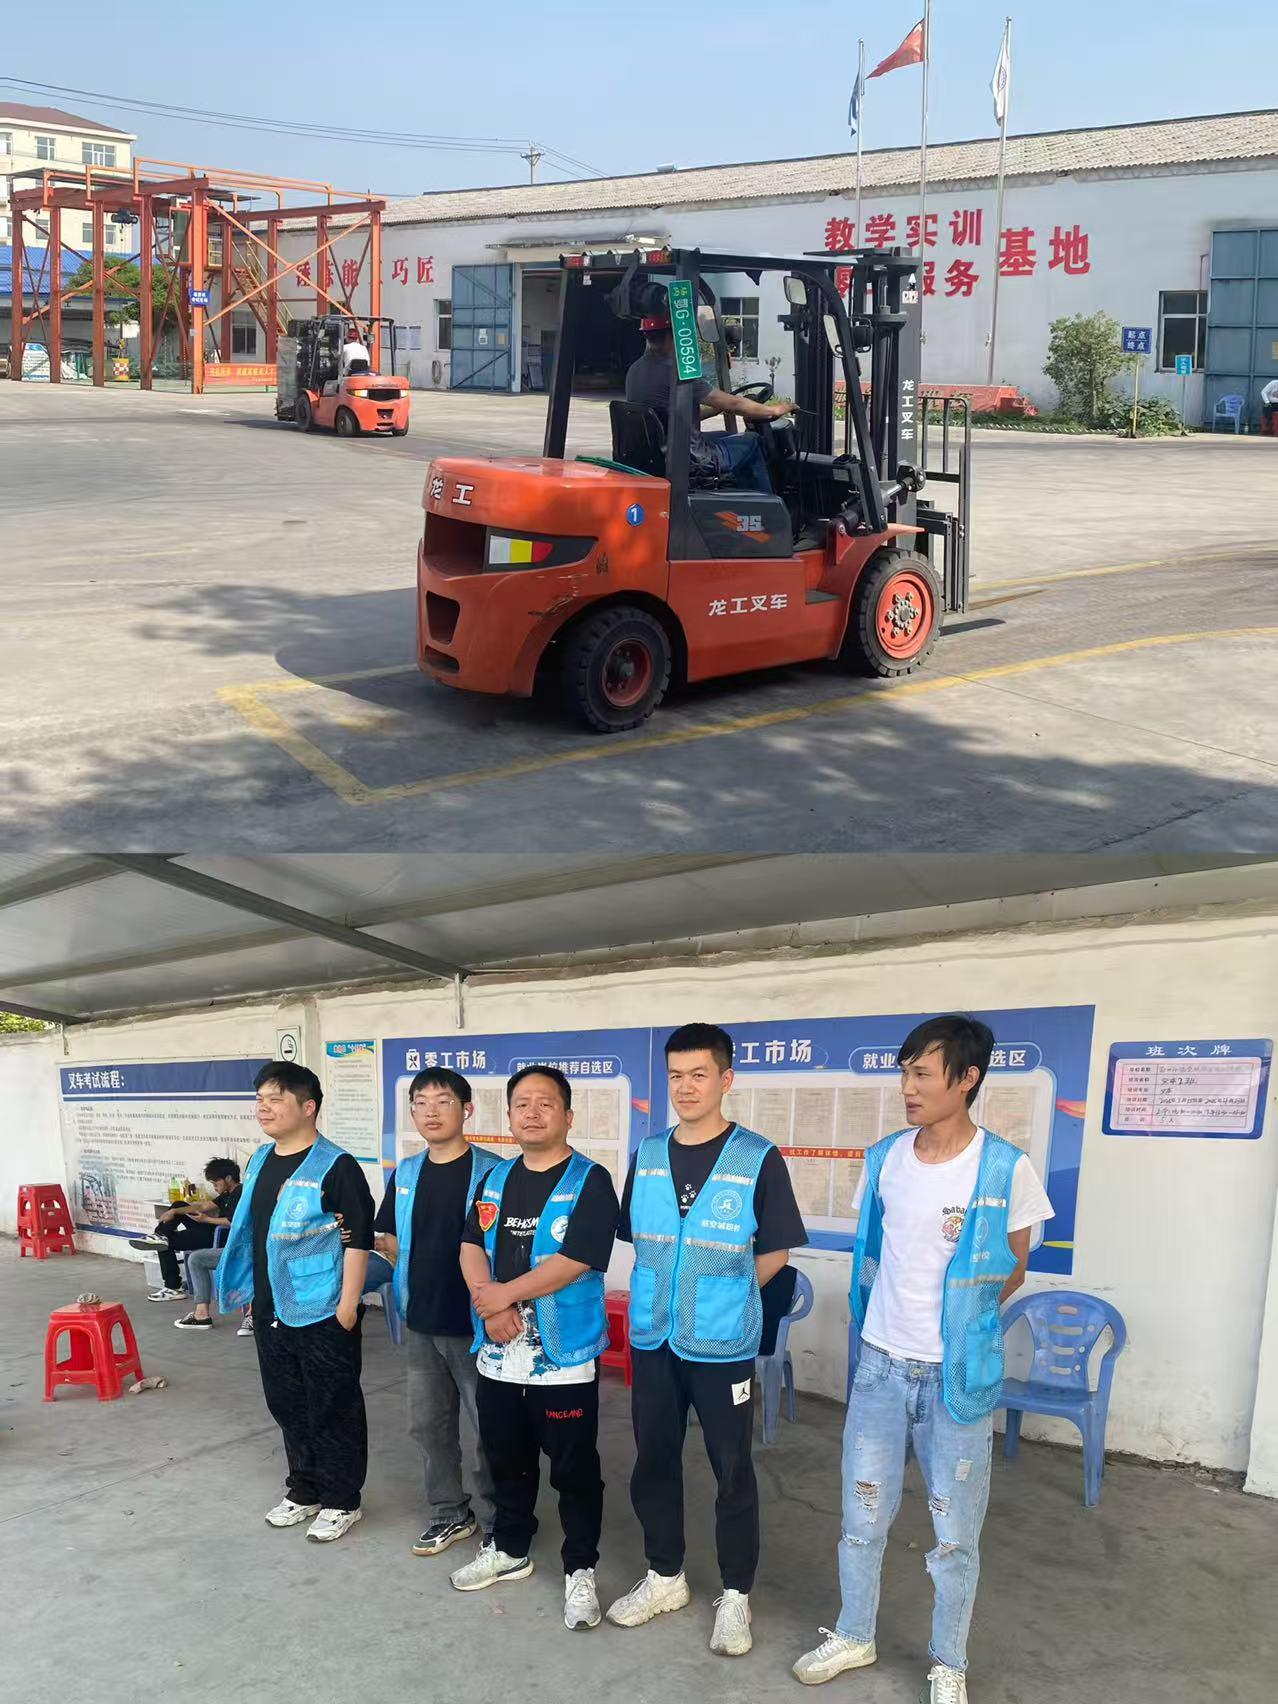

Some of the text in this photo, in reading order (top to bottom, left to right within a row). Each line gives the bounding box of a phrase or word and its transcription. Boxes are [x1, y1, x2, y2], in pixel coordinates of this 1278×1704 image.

[824, 208, 983, 251] 教学实训
[1000, 225, 1091, 276] 基地
[901, 379, 915, 440] 龙工叉车
[736, 515, 762, 532] 35
[708, 593, 788, 617] 龙工叉车
[424, 1050, 487, 1069] 零工市场
[732, 1038, 811, 1064] 工市场
[1145, 1043, 1233, 1057] 班次牌
